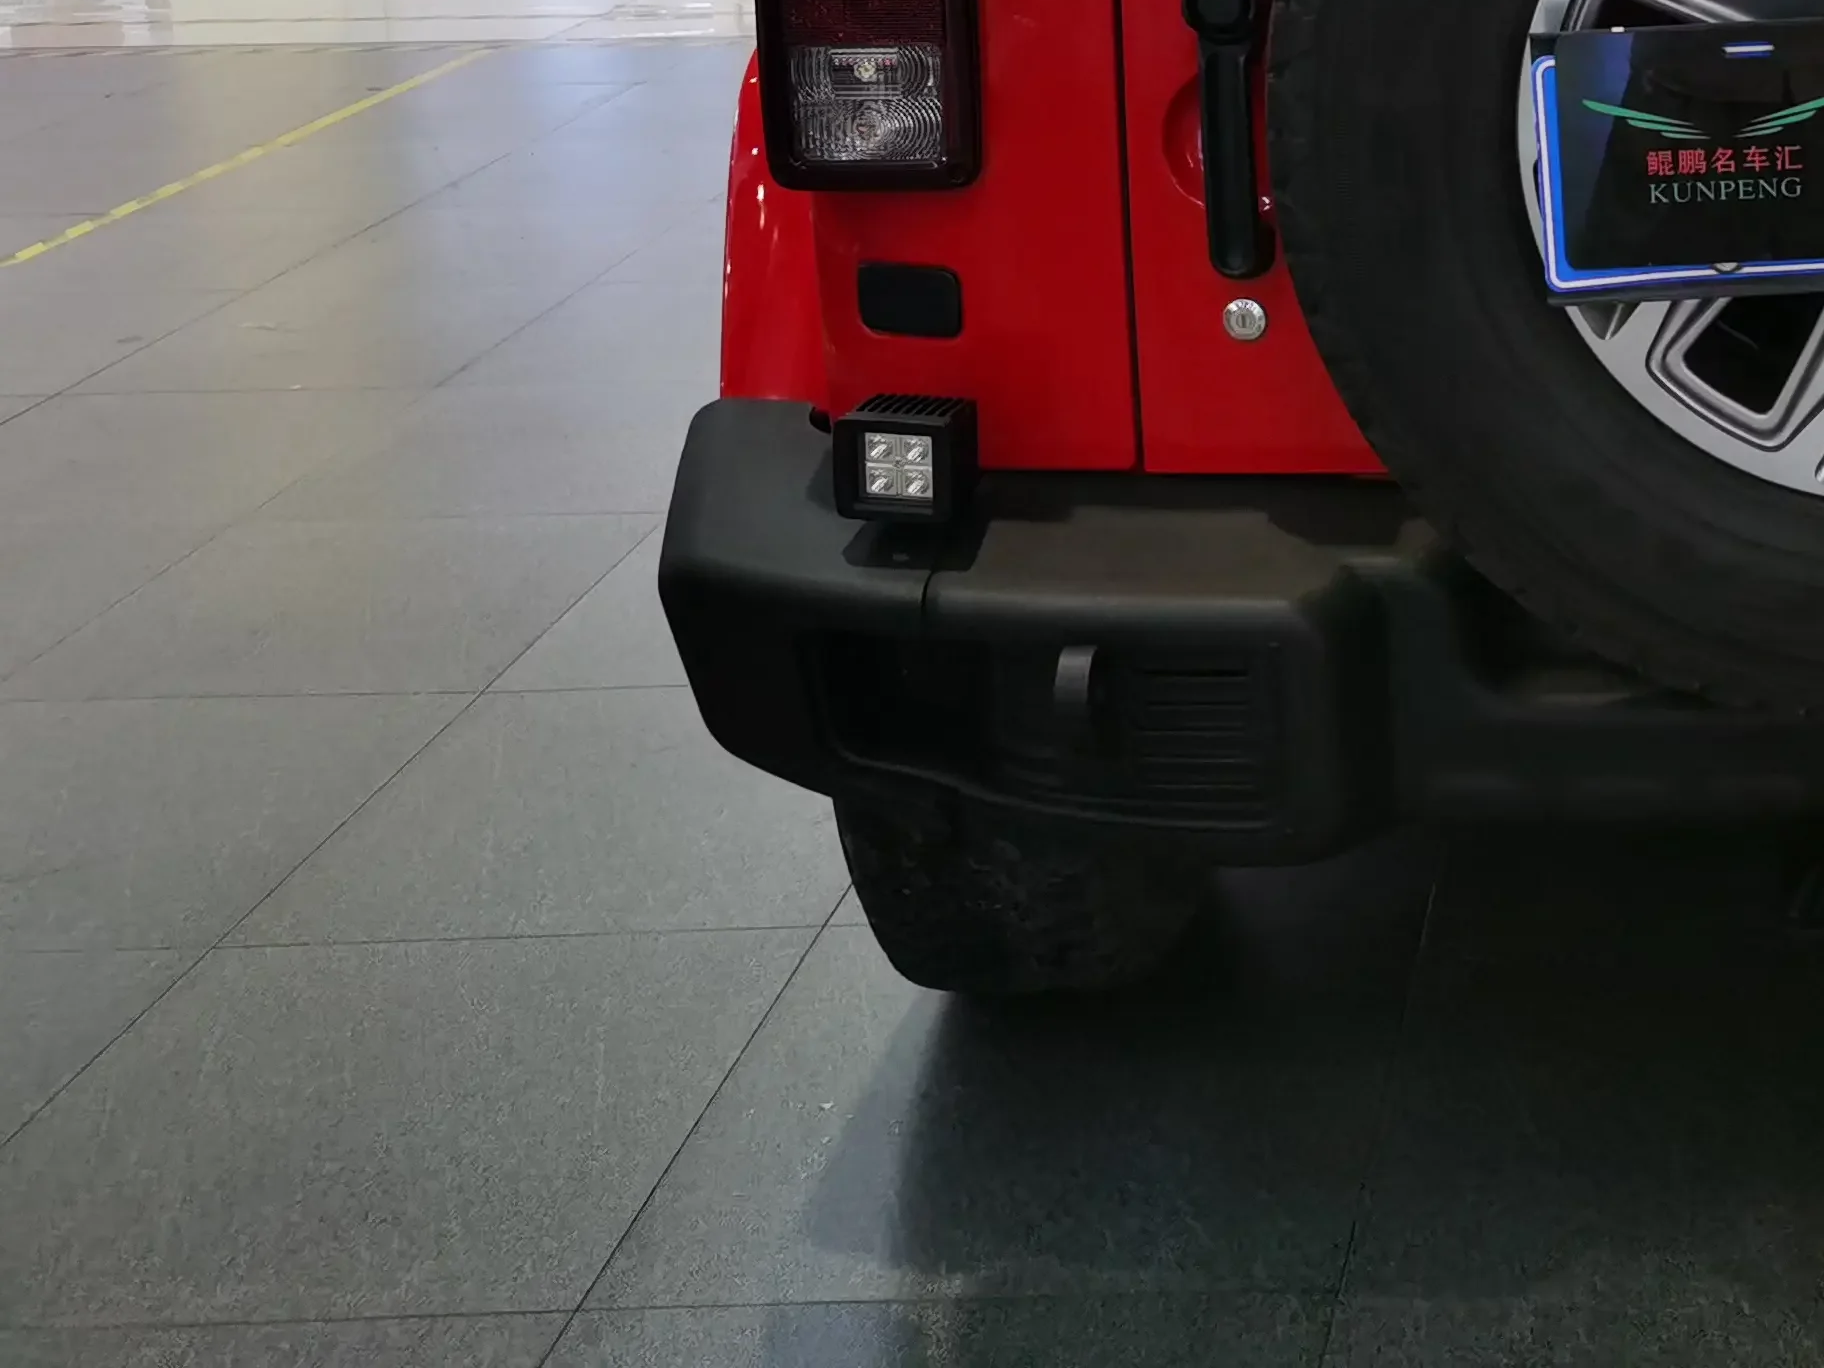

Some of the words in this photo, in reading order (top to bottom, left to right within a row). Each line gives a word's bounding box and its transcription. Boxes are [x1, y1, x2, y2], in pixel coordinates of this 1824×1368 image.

[1646, 145, 1803, 177] 鲲鹏名车汇
[1648, 176, 1803, 204] KUNPENG
